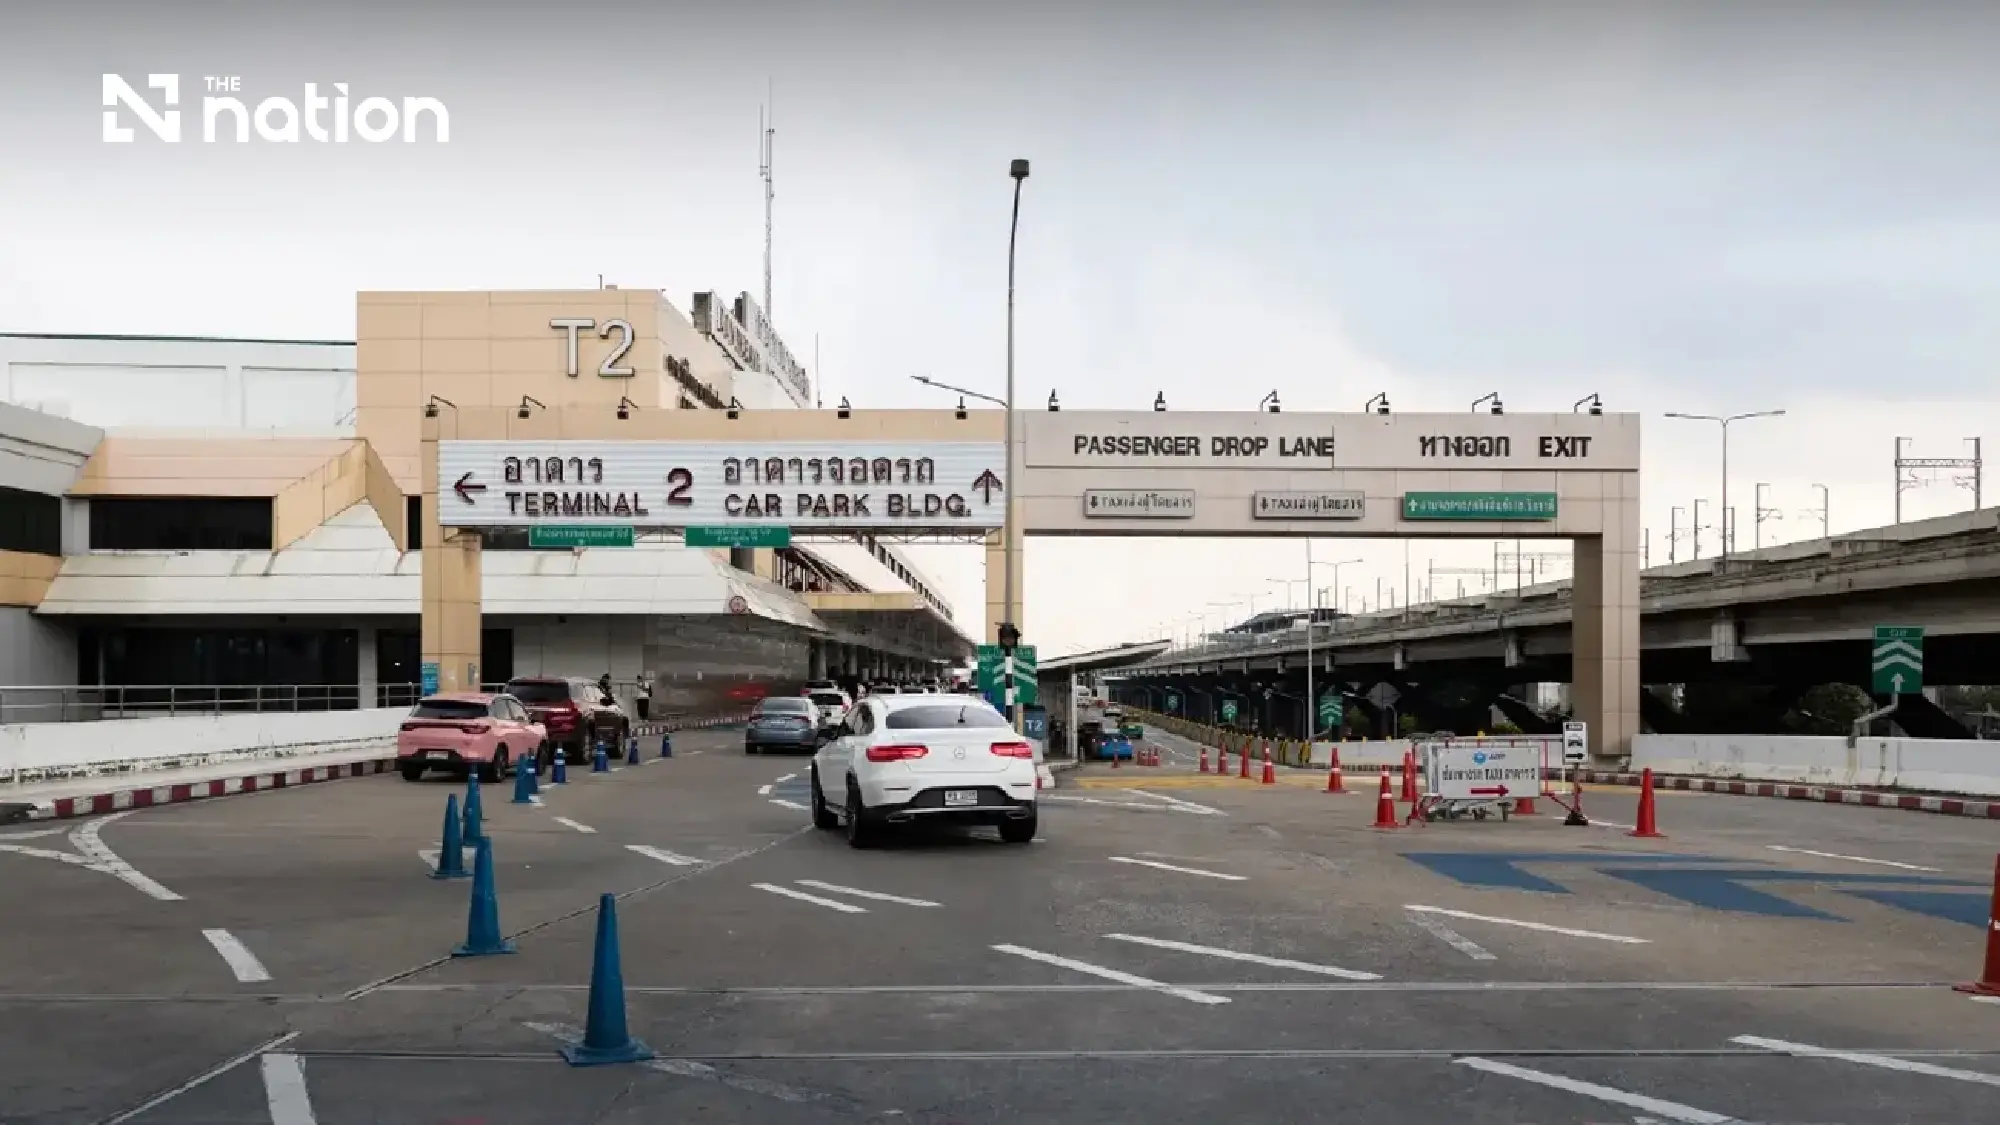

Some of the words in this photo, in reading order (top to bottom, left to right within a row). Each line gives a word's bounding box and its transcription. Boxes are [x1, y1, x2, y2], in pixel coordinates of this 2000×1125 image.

[549, 318, 635, 377] T2
[1074, 436, 1201, 457] PASSENGER
[1212, 437, 1269, 457] DROP
[1280, 437, 1335, 457] LANE
[1419, 436, 1510, 458] ทางออก
[1539, 436, 1592, 458] EXIT
[504, 456, 602, 484] อาคาร
[723, 456, 935, 484] อาคารจอดรถ
[667, 468, 693, 506] 2
[505, 491, 649, 517] TERMINAL
[724, 493, 783, 517] CAR
[796, 493, 869, 517] PARK
[887, 493, 972, 518] BLDG.
[1025, 720, 1042, 731] T2
